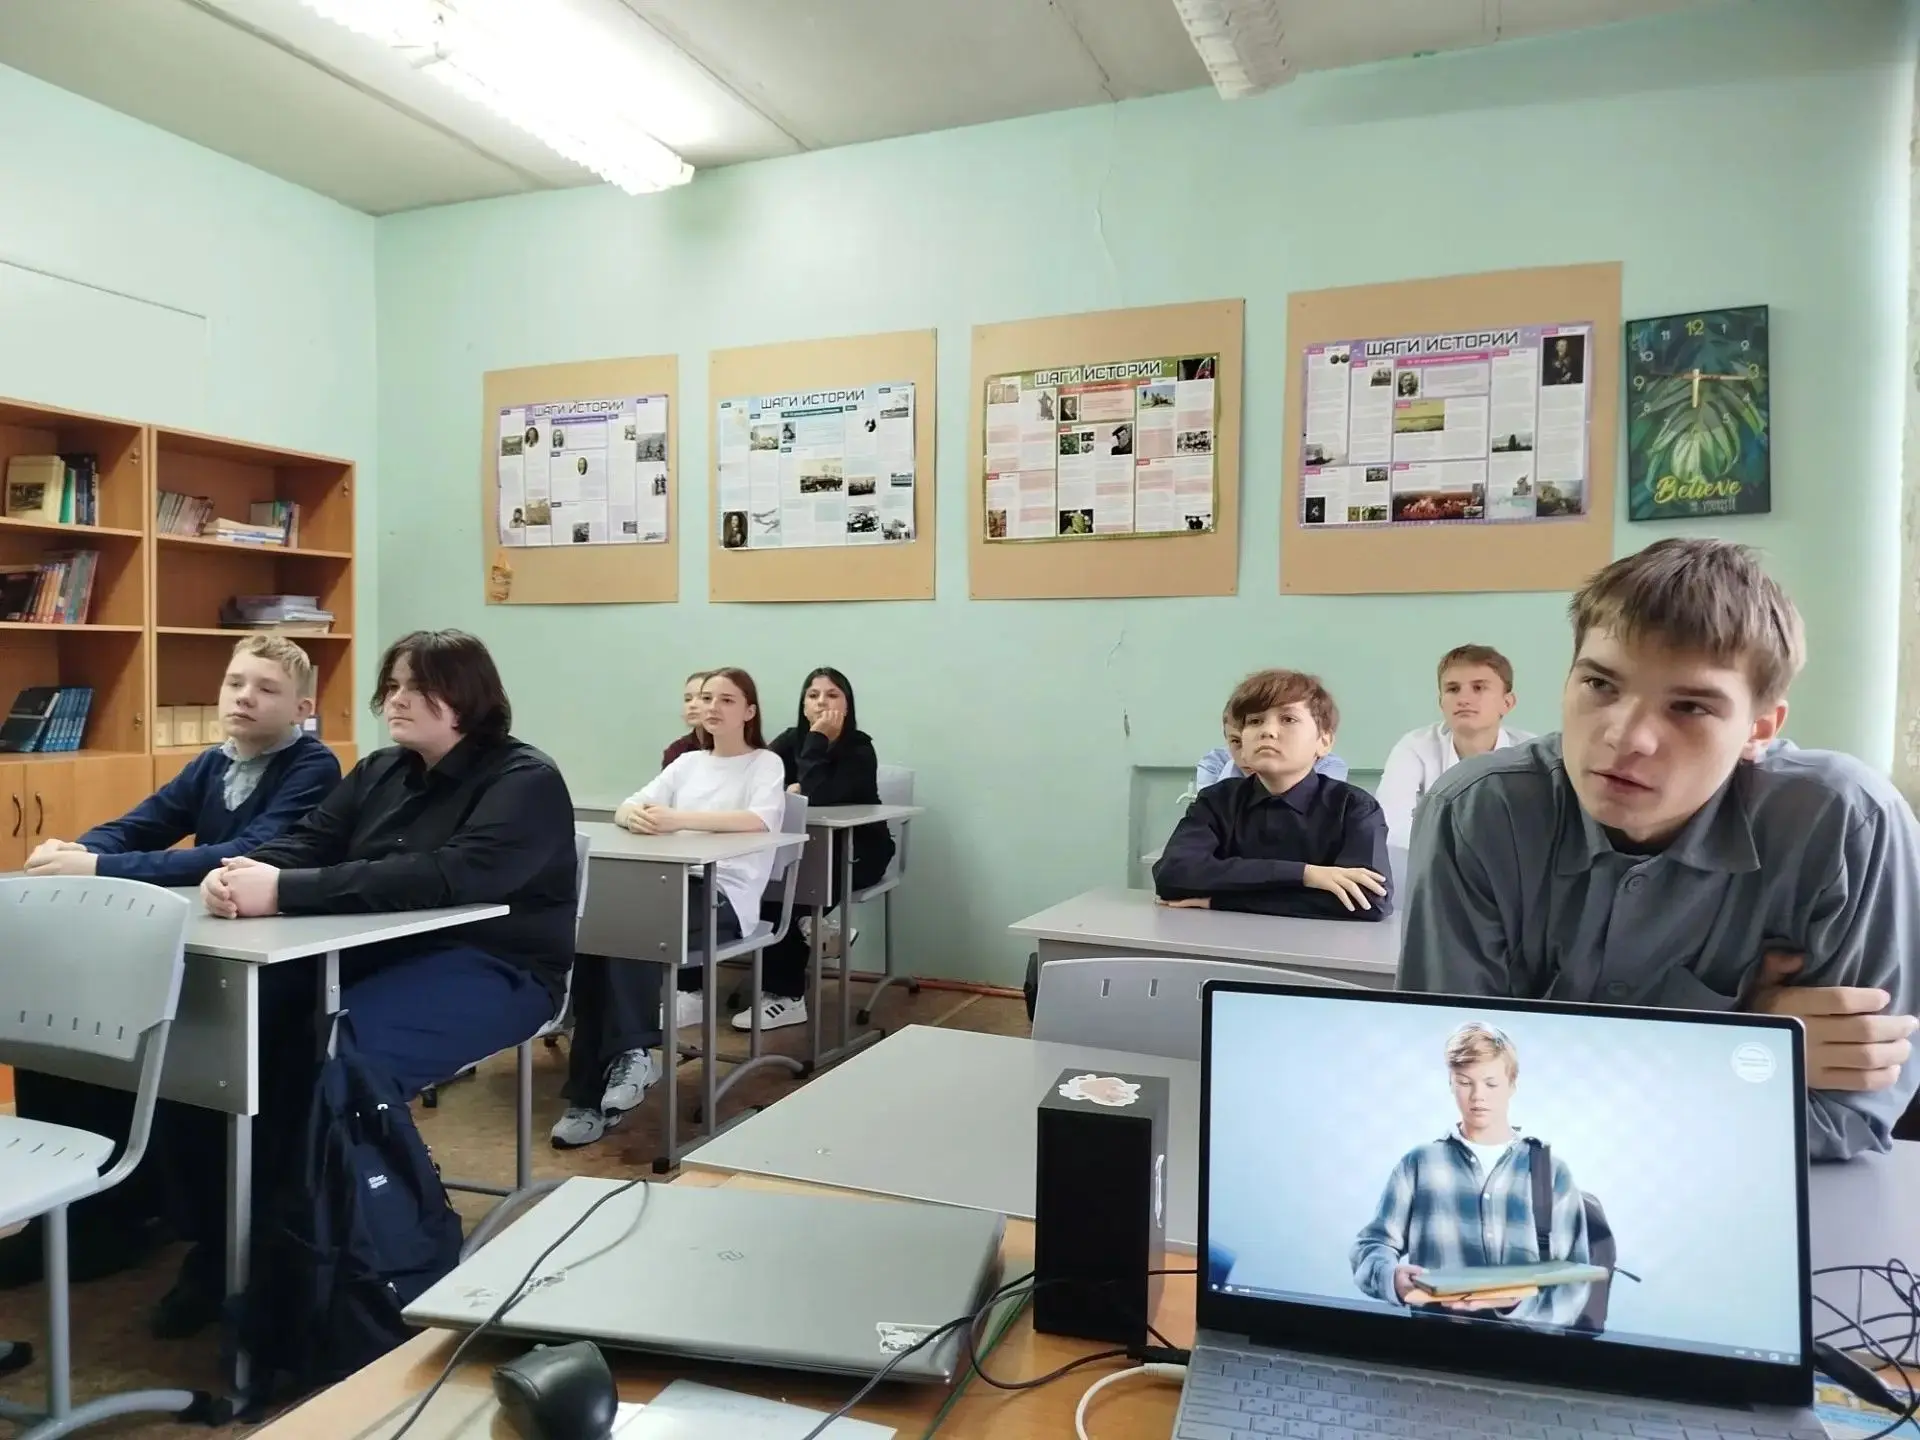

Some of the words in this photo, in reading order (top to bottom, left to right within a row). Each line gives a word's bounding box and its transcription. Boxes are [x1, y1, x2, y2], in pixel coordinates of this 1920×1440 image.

[1661, 330, 1670, 340] 11
[1685, 319, 1704, 336] 12
[1721, 323, 1726, 334] 1
[1367, 340, 1419, 356] ШАГИ
[1427, 332, 1518, 351] ИСТОРИИ
[1640, 350, 1654, 362] 10
[1036, 369, 1079, 385] ШАГИ
[1085, 361, 1160, 379] ИСТОРИИ
[1634, 375, 1644, 391] 9
[761, 396, 798, 409] ШАГИ
[802, 390, 865, 405] ИСТОРИИ
[535, 405, 565, 416] ШАГИ
[569, 400, 624, 414] ИСТОРИИ
[1655, 475, 1742, 504] Believe
